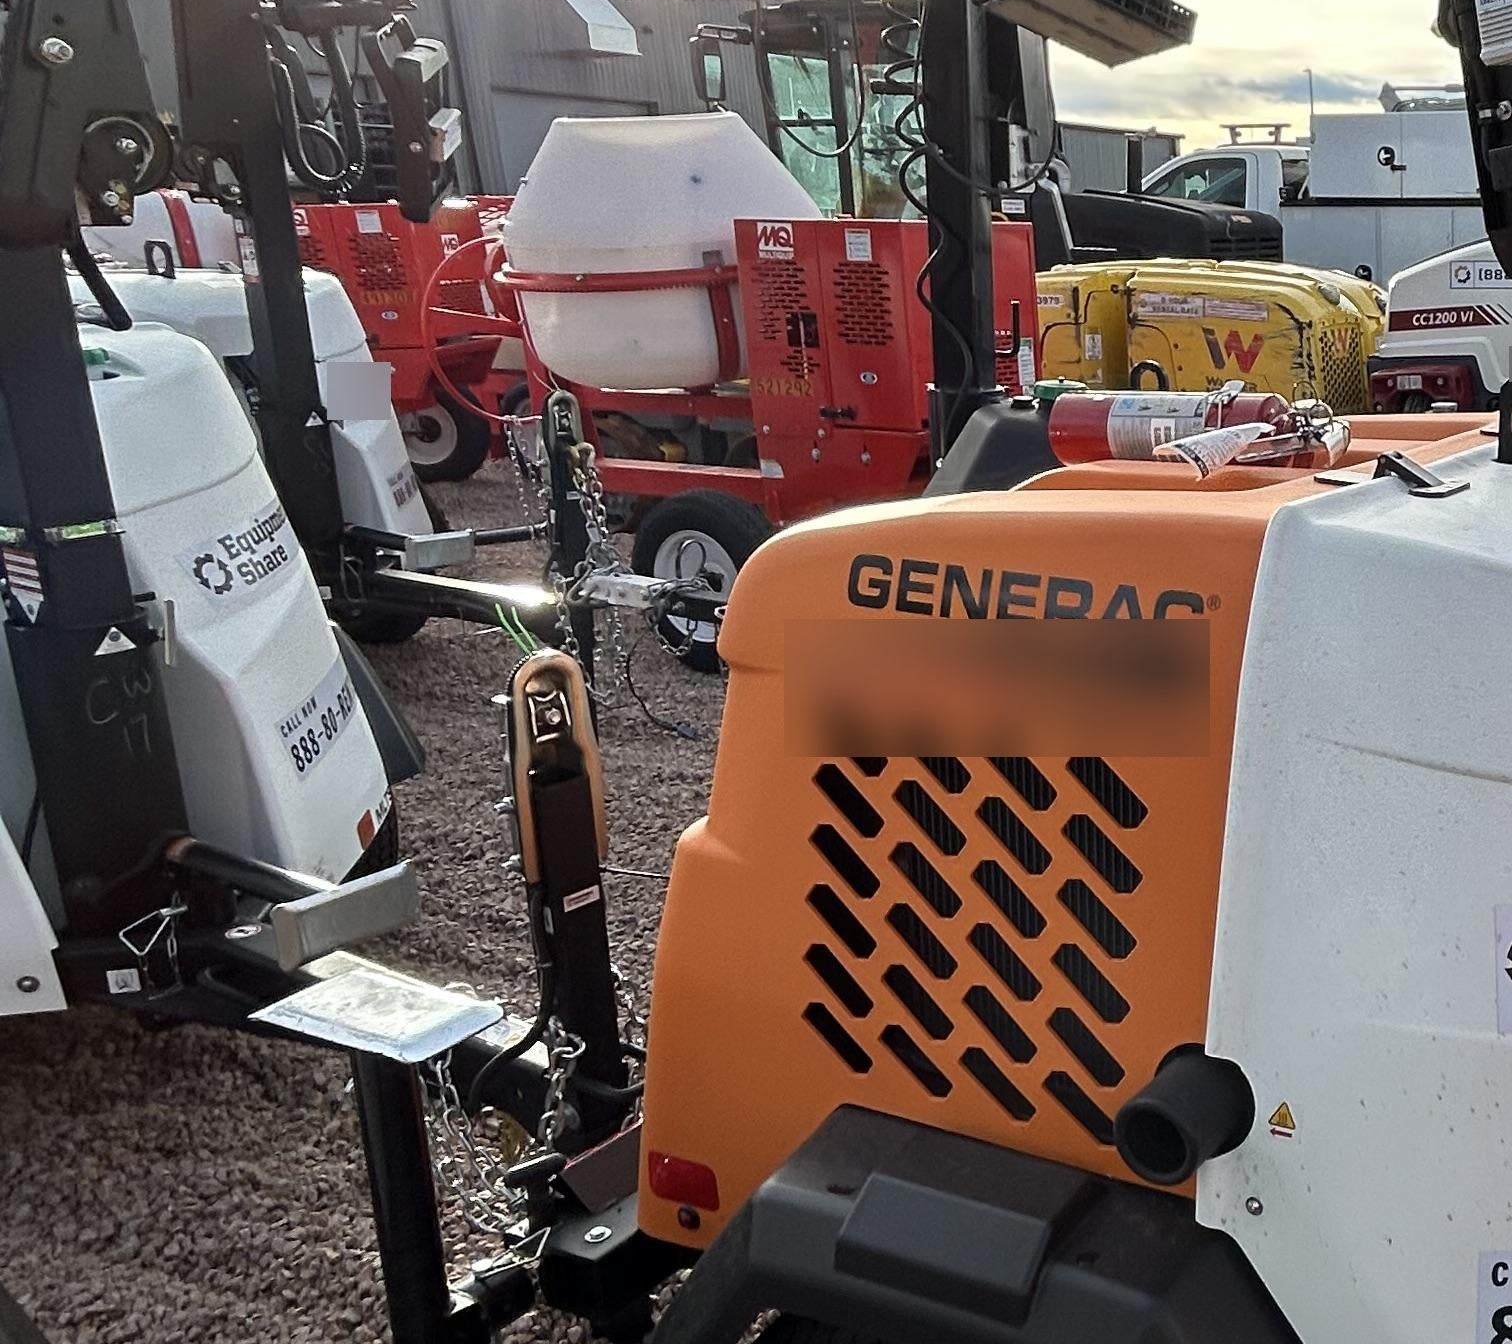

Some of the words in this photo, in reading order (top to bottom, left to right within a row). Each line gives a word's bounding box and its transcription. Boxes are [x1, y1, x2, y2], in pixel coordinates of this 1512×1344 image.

[1412, 311, 1459, 327] CC1200
[1461, 310, 1474, 324] VI
[236, 544, 289, 586] Share
[280, 713, 303, 738] CALL
[302, 696, 318, 718] NOW
